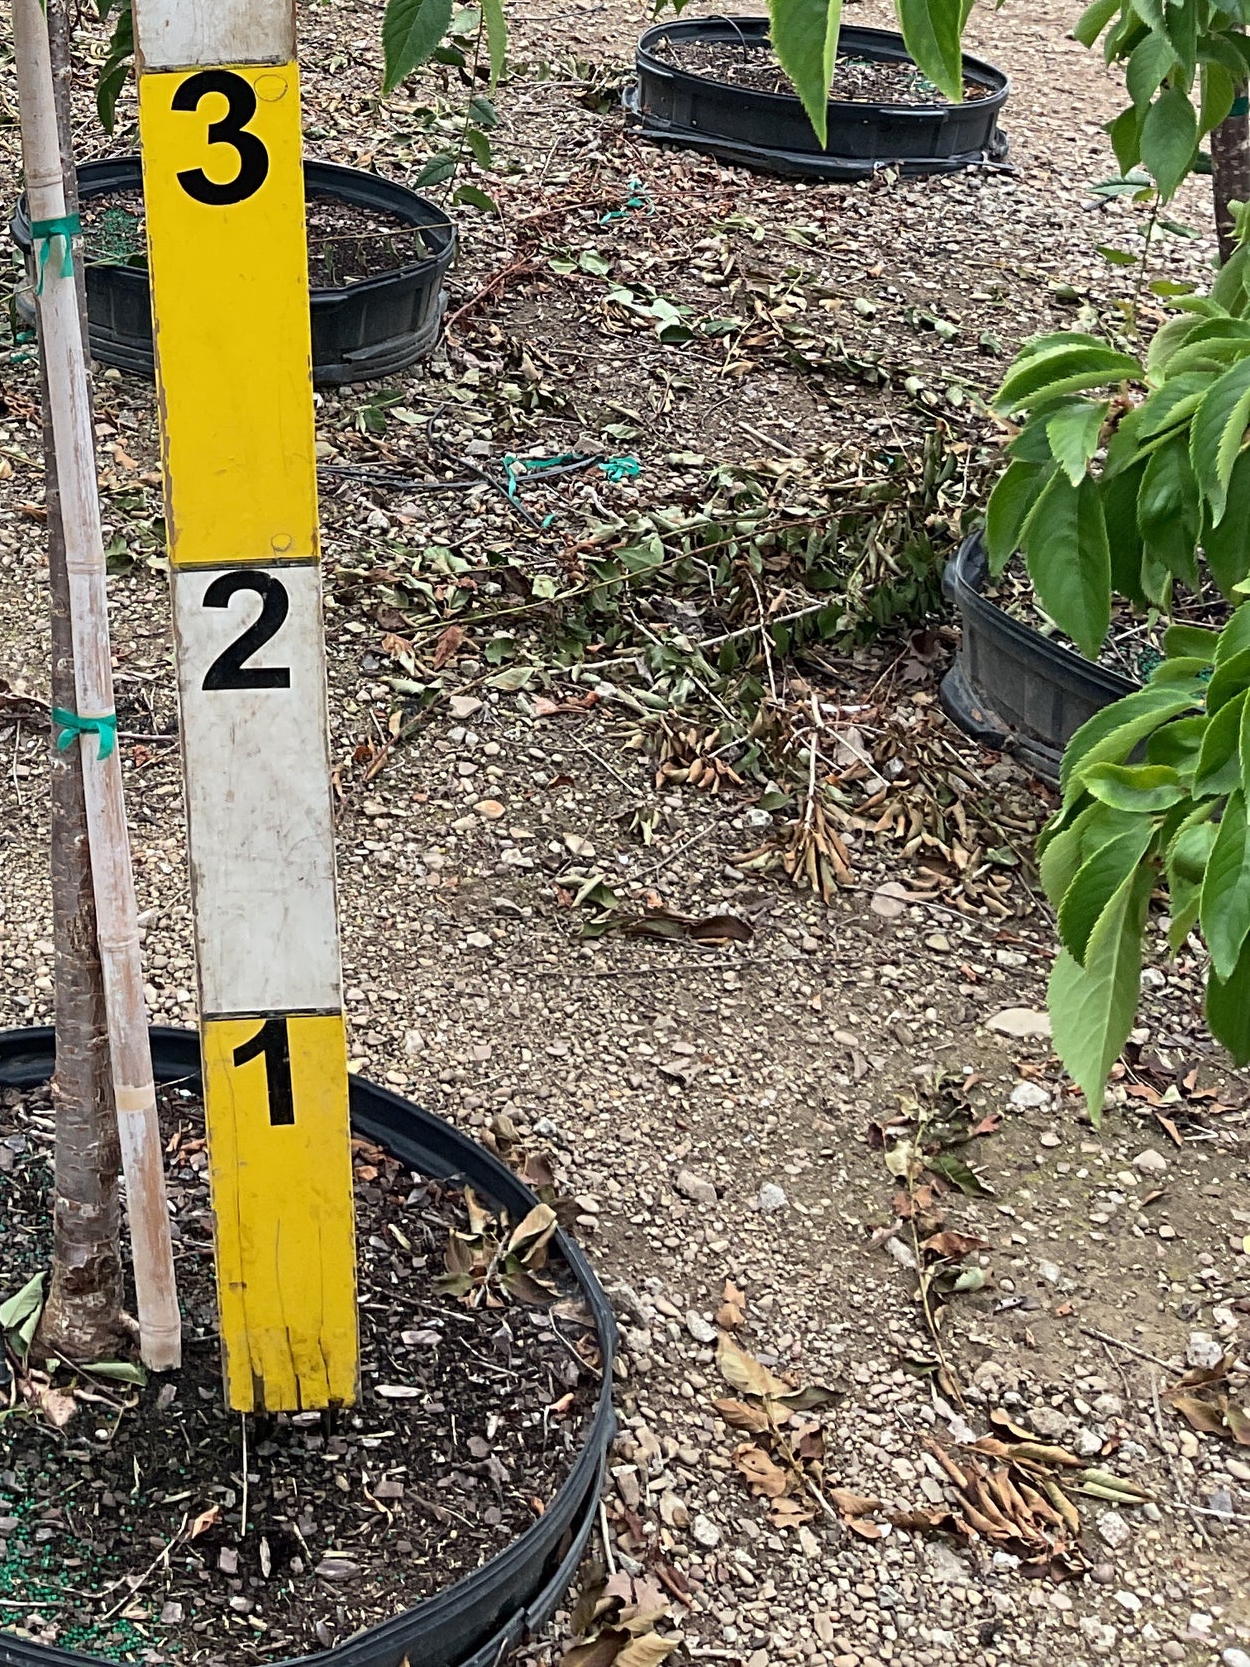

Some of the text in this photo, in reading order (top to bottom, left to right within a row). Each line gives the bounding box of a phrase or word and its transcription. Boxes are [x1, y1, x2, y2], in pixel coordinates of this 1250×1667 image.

[171, 69, 269, 206] 3
[201, 569, 291, 691] 2
[233, 1019, 296, 1127] 1
